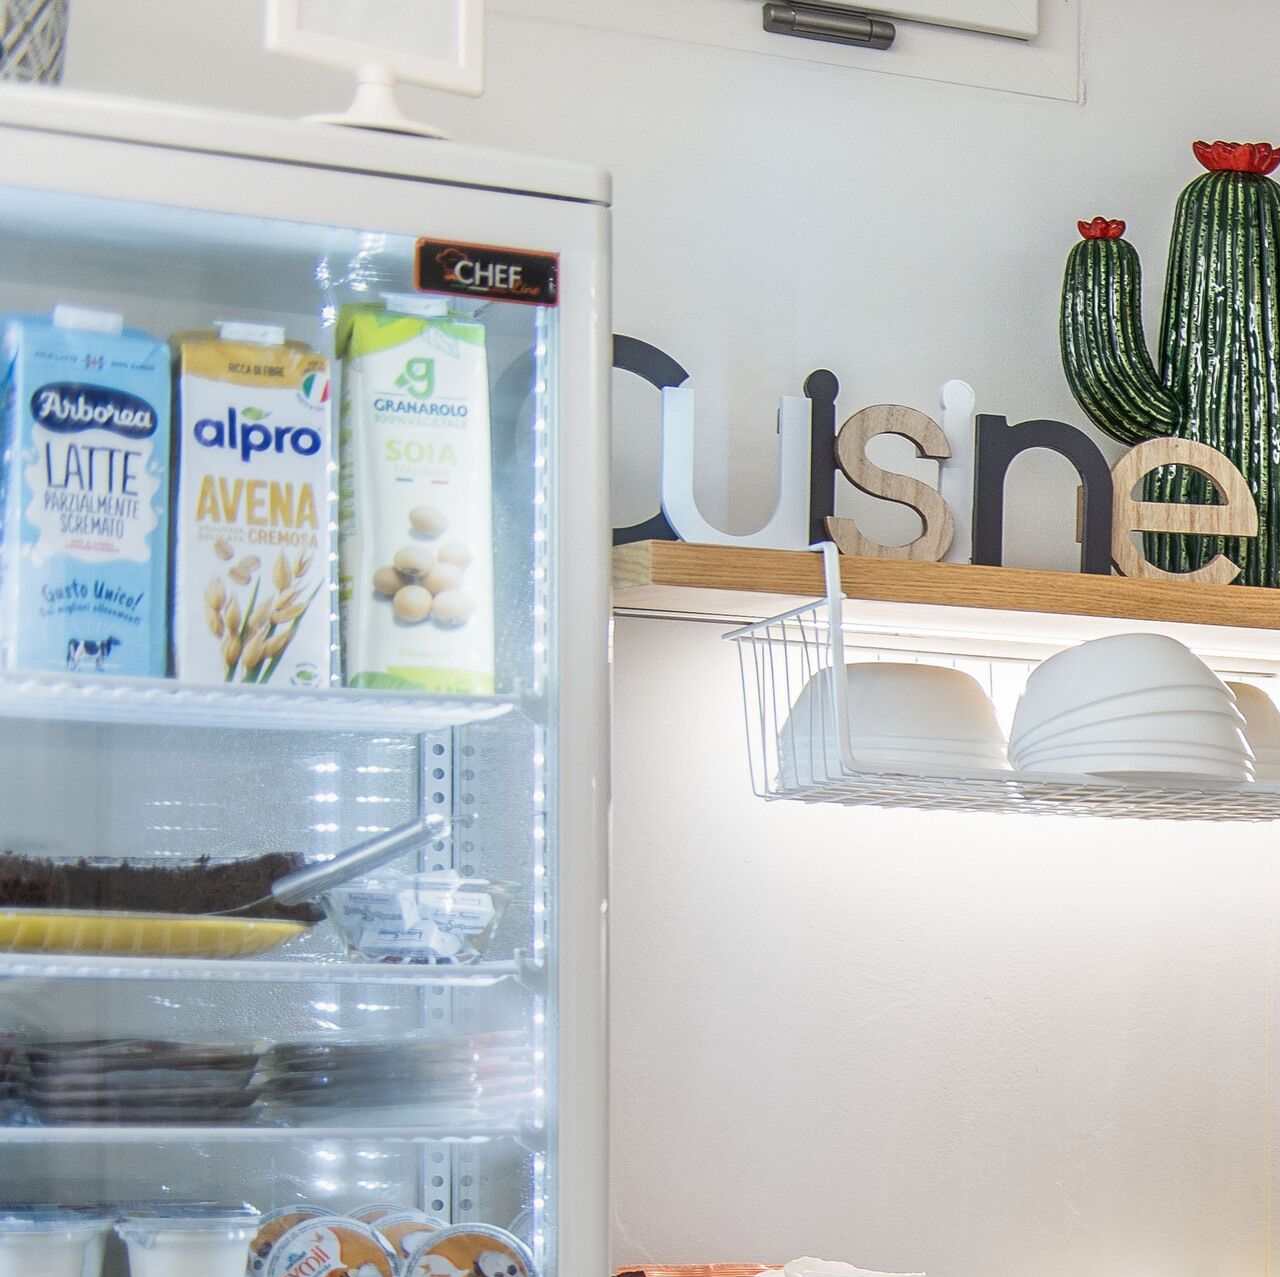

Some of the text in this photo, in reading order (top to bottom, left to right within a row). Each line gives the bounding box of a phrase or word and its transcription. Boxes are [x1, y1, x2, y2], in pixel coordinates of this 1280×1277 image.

[454, 260, 522, 289] CHEF
[229, 362, 253, 375] RICCA
[263, 366, 286, 378] FIBRE
[38, 391, 153, 428] Arborea
[374, 399, 468, 417] GRANAROLO
[194, 406, 321, 463] alpro
[384, 438, 458, 466] SOIA
[45, 442, 142, 497] LATTE
[43, 493, 140, 520] PARZIALMENTE
[195, 473, 320, 530] AVENA
[60, 514, 125, 539] SCREMATO
[247, 527, 319, 549] CREMOSA
[42, 579, 145, 611] Gusto Unico!
